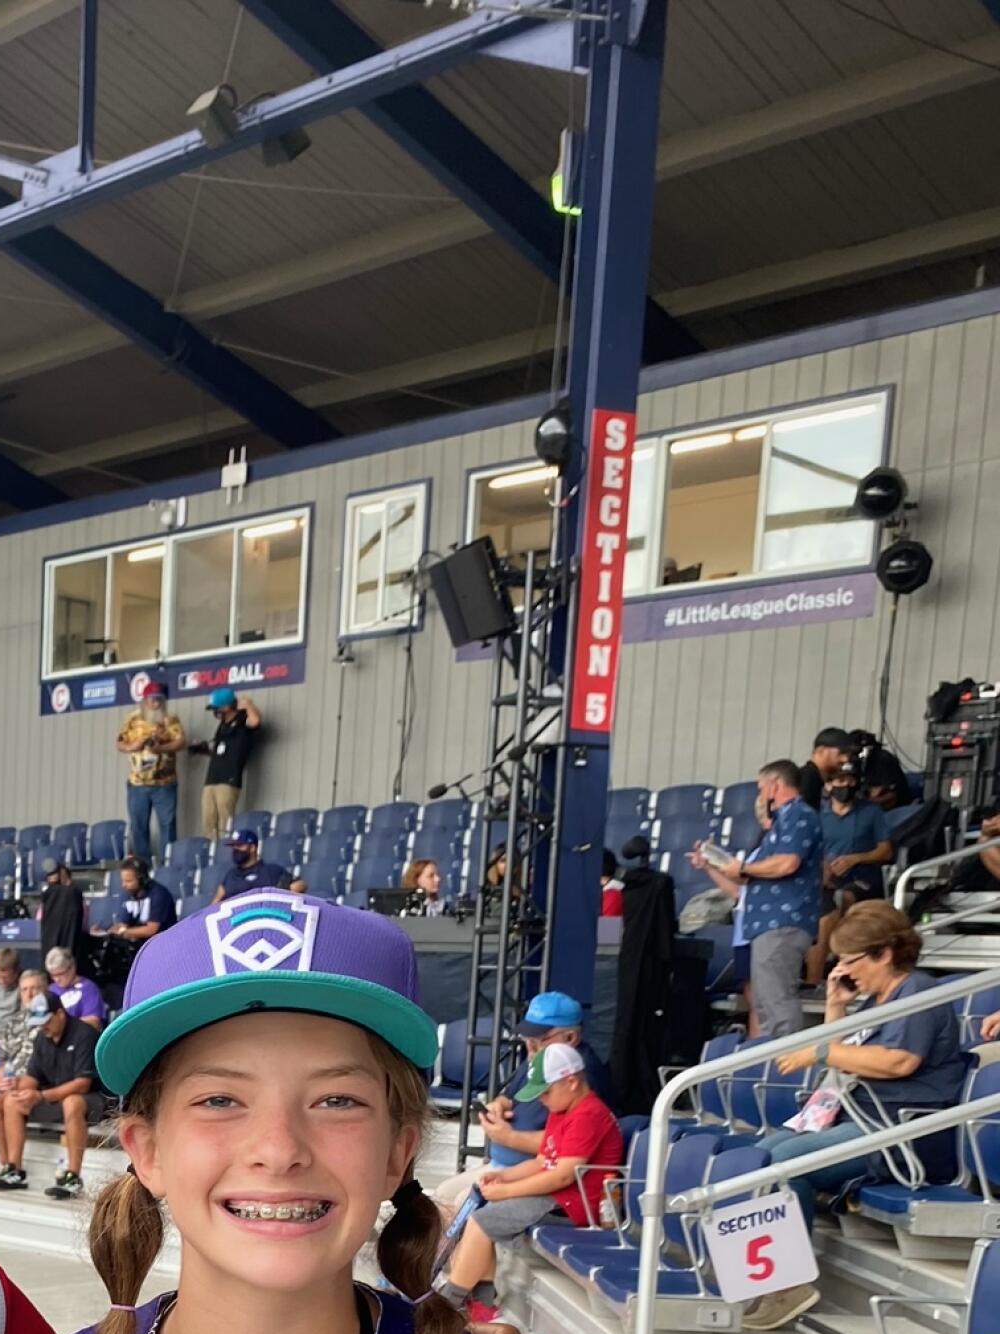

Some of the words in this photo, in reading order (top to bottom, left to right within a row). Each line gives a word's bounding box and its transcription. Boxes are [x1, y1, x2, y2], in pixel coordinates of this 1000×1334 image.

[587, 418, 627, 678] SECTION
[664, 588, 854, 626] #LittleLeagueClassic
[585, 693, 606, 725] 5
[718, 1204, 786, 1236] SECTION
[746, 1235, 775, 1281] 5
